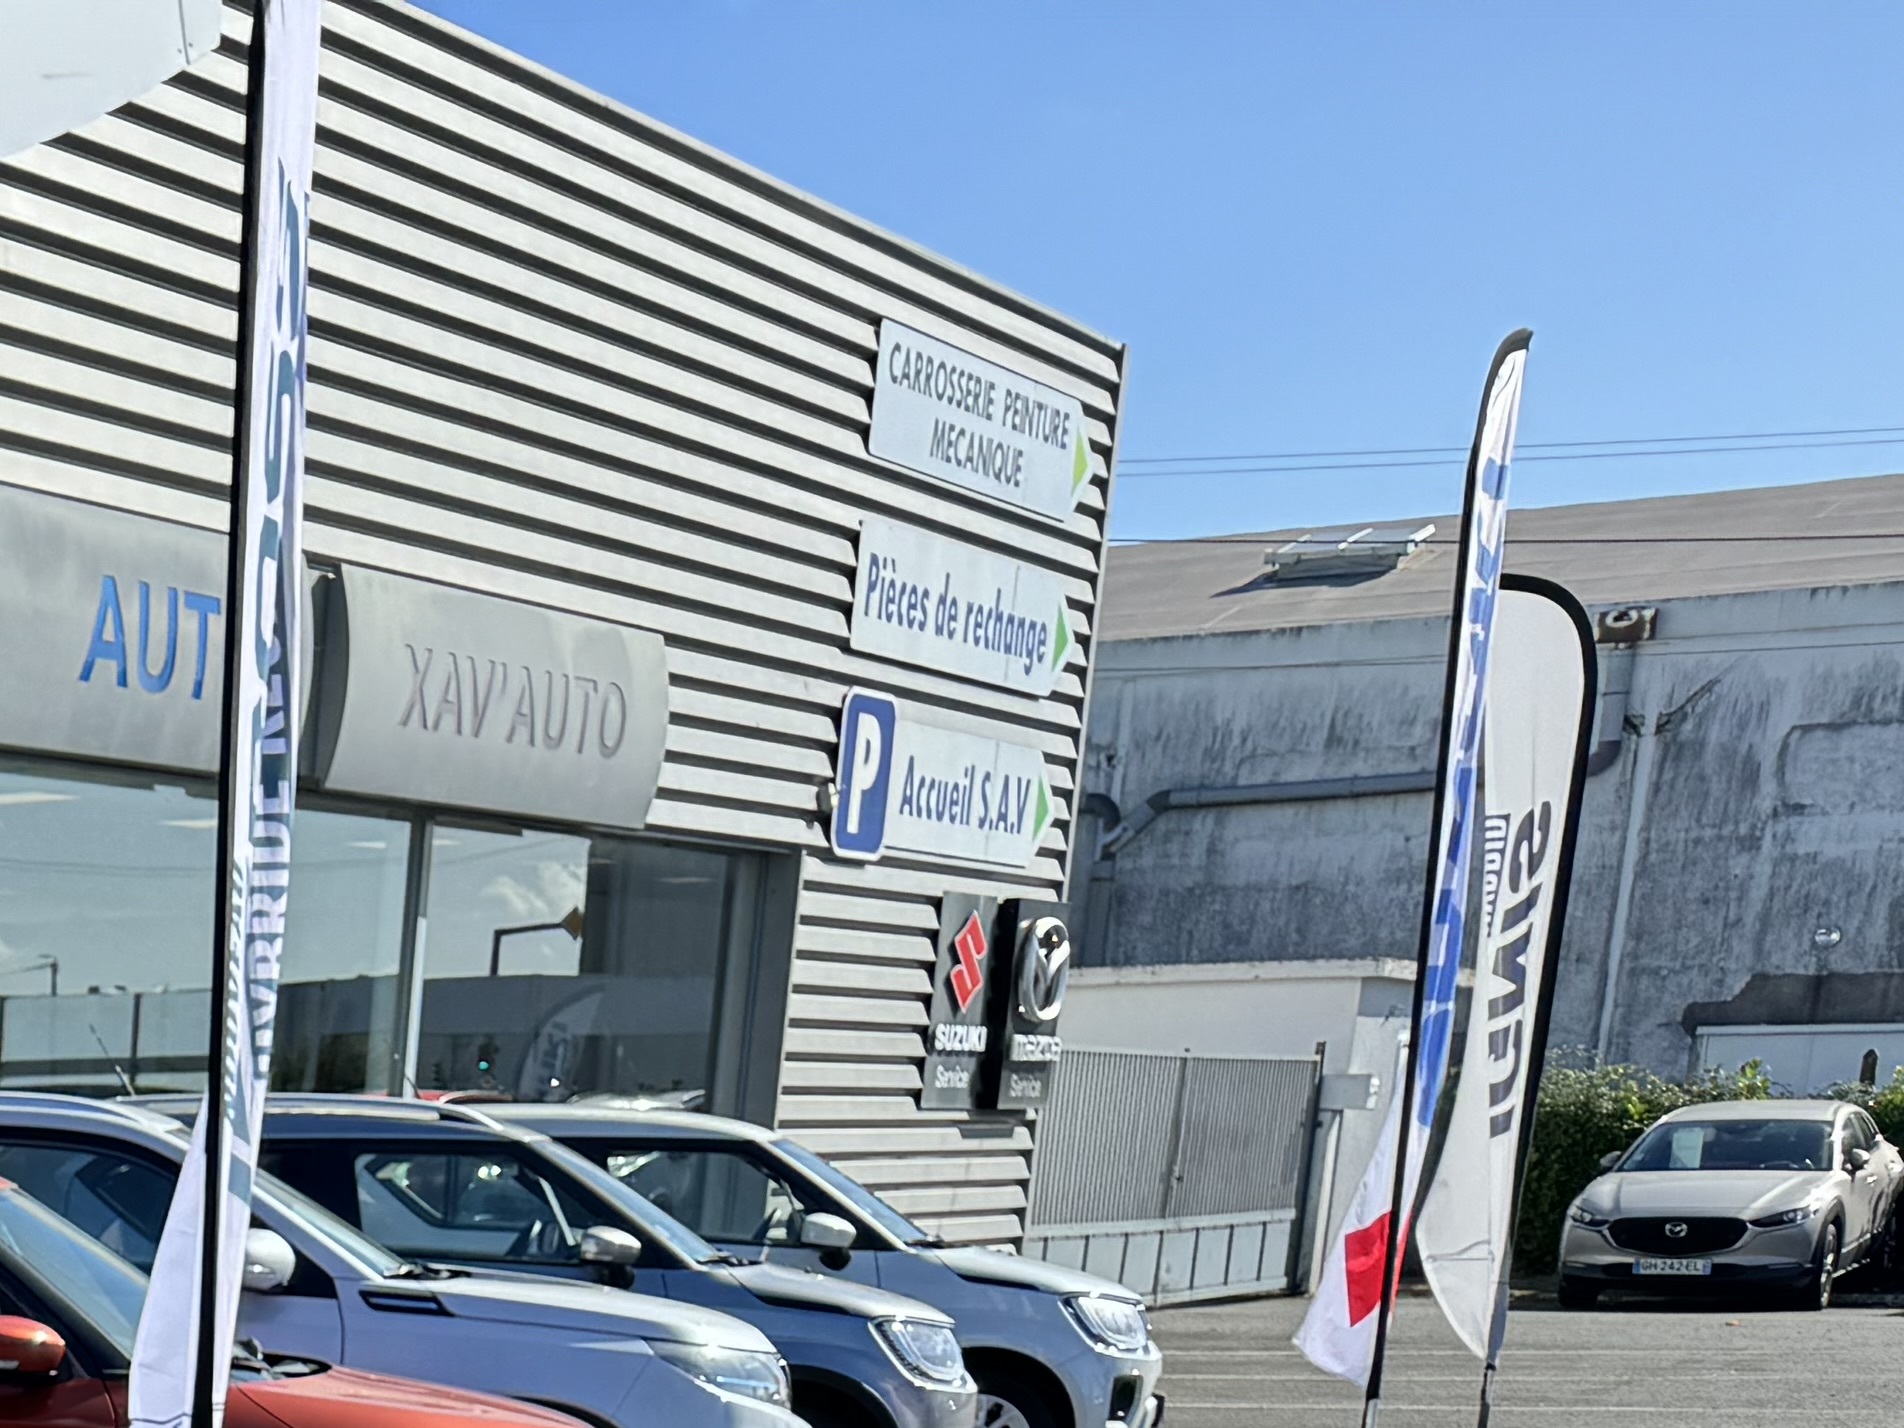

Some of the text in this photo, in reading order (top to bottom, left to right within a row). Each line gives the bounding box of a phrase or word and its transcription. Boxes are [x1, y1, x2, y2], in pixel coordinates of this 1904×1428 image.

[889, 342, 1072, 451] CARROSSERIE PEINTURE
[929, 416, 1025, 490] MECANIQUE
[78, 572, 222, 702] AUT
[863, 550, 1048, 676] Pièces de rechange
[399, 641, 628, 761] XAV'AUTO
[847, 712, 881, 834] P
[898, 755, 1032, 836] Accueil S.A.V
[935, 1022, 988, 1054] SUZUKI
